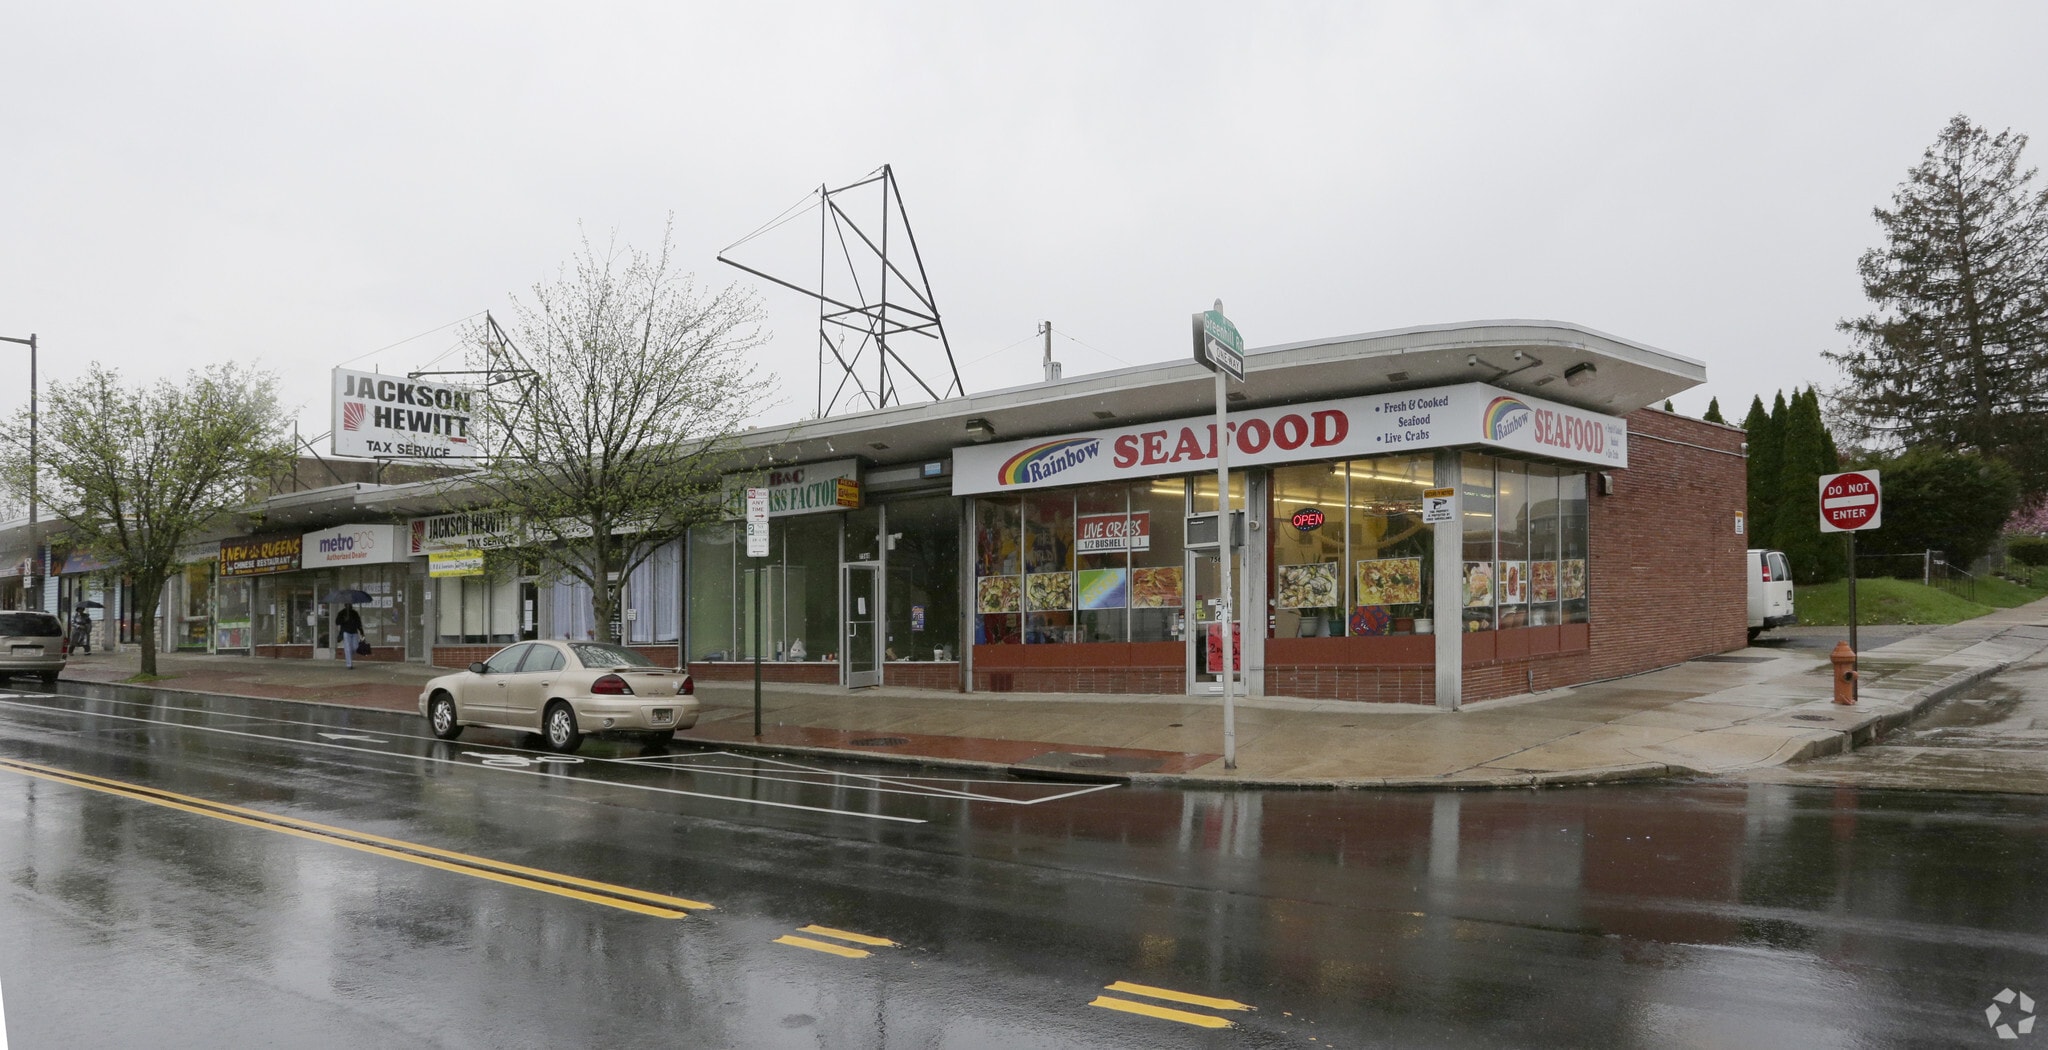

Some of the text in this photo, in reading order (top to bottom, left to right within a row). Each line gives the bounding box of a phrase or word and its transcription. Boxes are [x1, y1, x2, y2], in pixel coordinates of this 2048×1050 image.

[1228, 356, 1240, 371] WAY
[344, 375, 470, 412] JACKSON
[1384, 395, 1449, 414] Fresh & Cooked
[374, 405, 469, 437] HEWITT
[1398, 414, 1431, 427] Seafood
[1384, 430, 1430, 444] Live Crabs
[1496, 408, 1604, 454] Rainbow SEAFOOD
[366, 440, 450, 458] TAX SERVICE
[1031, 409, 1349, 483] Rainbow SEAFOOD
[1828, 482, 1869, 496] DO NOT
[1293, 513, 1323, 527] OPEN
[1832, 508, 1867, 520] ENTER
[429, 512, 469, 540] JACKSON
[1084, 520, 1141, 538] LIVE CRABS
[227, 547, 248, 561] NEW
[261, 539, 300, 559] QUEENS
[320, 531, 375, 553] metroPCS
[467, 538, 481, 548] TAX
[1084, 540, 1094, 549] 1/2
[1095, 538, 1122, 548] BUSHEL
[326, 551, 367, 561] Authorized Dealer
